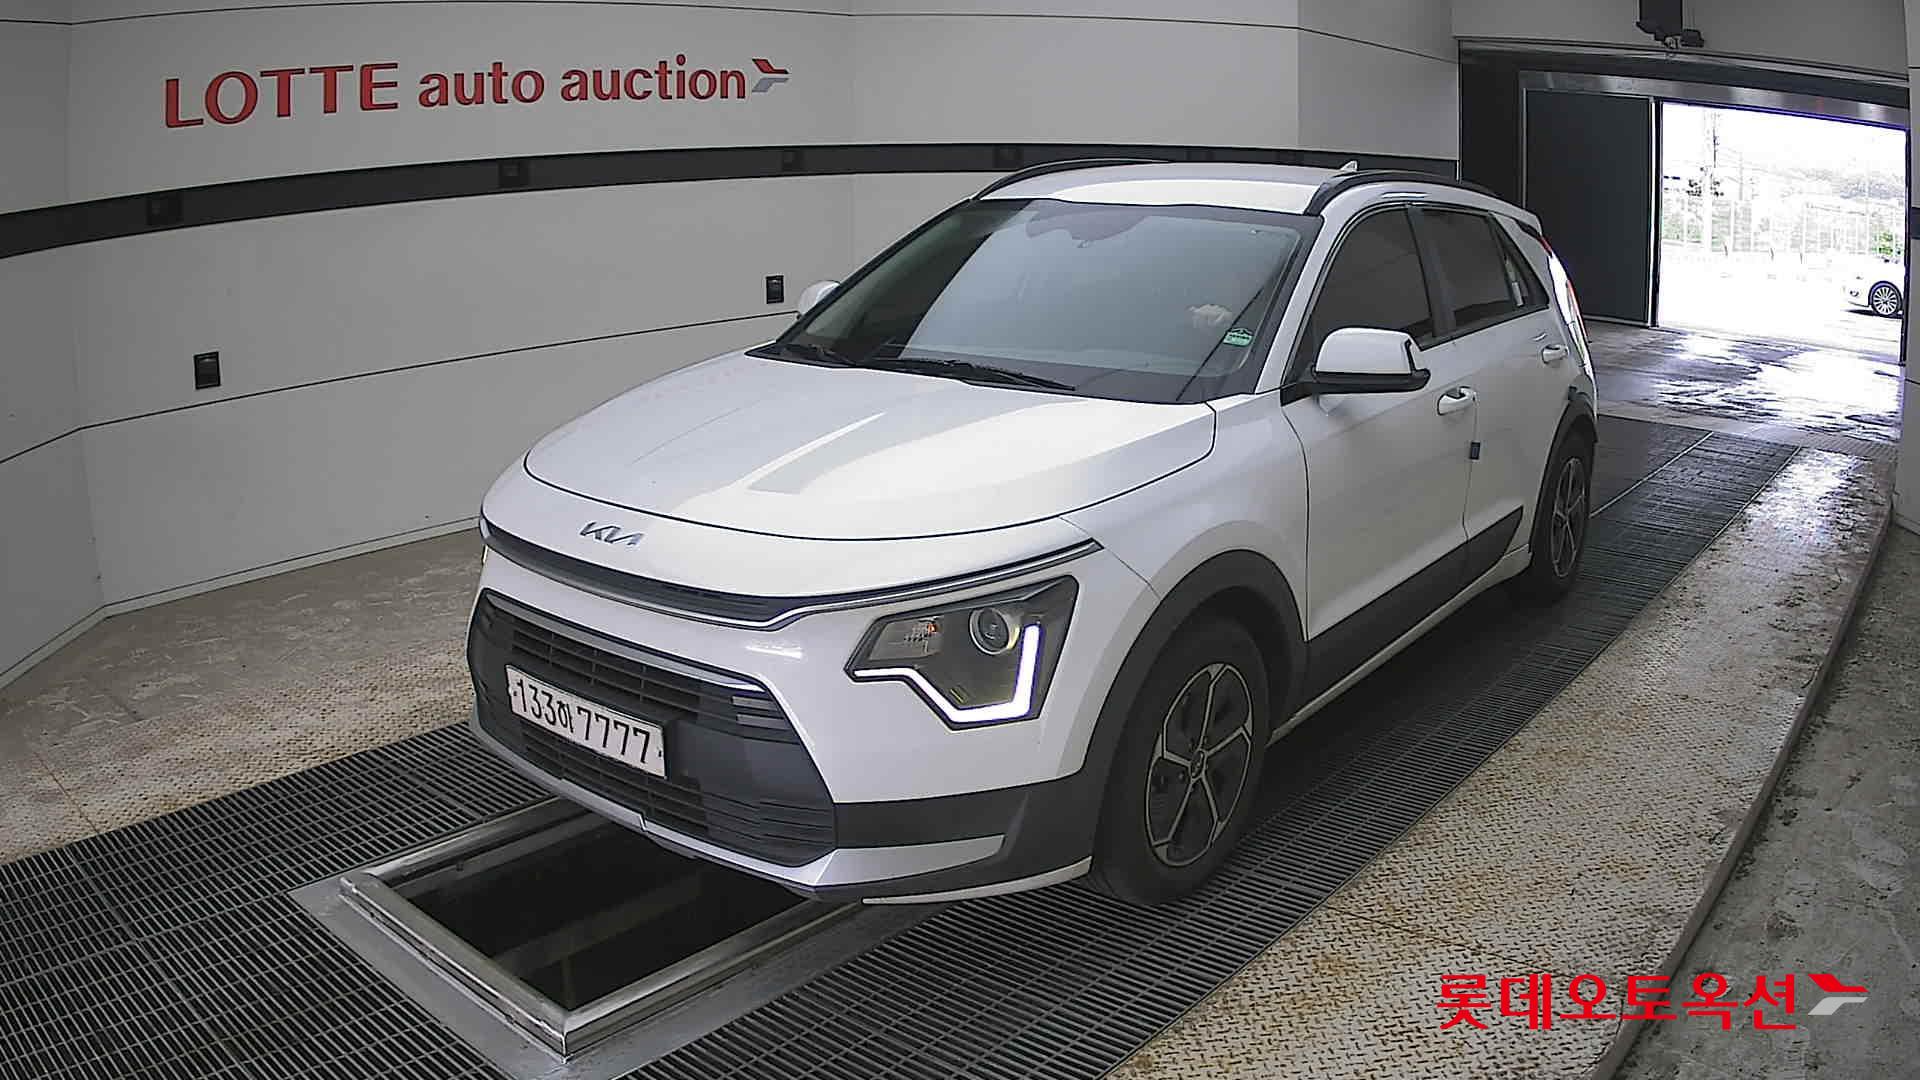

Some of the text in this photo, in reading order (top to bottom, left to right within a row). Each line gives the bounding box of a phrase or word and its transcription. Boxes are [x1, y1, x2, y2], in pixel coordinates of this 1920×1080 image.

[166, 54, 746, 128] LOTTE auto auction
